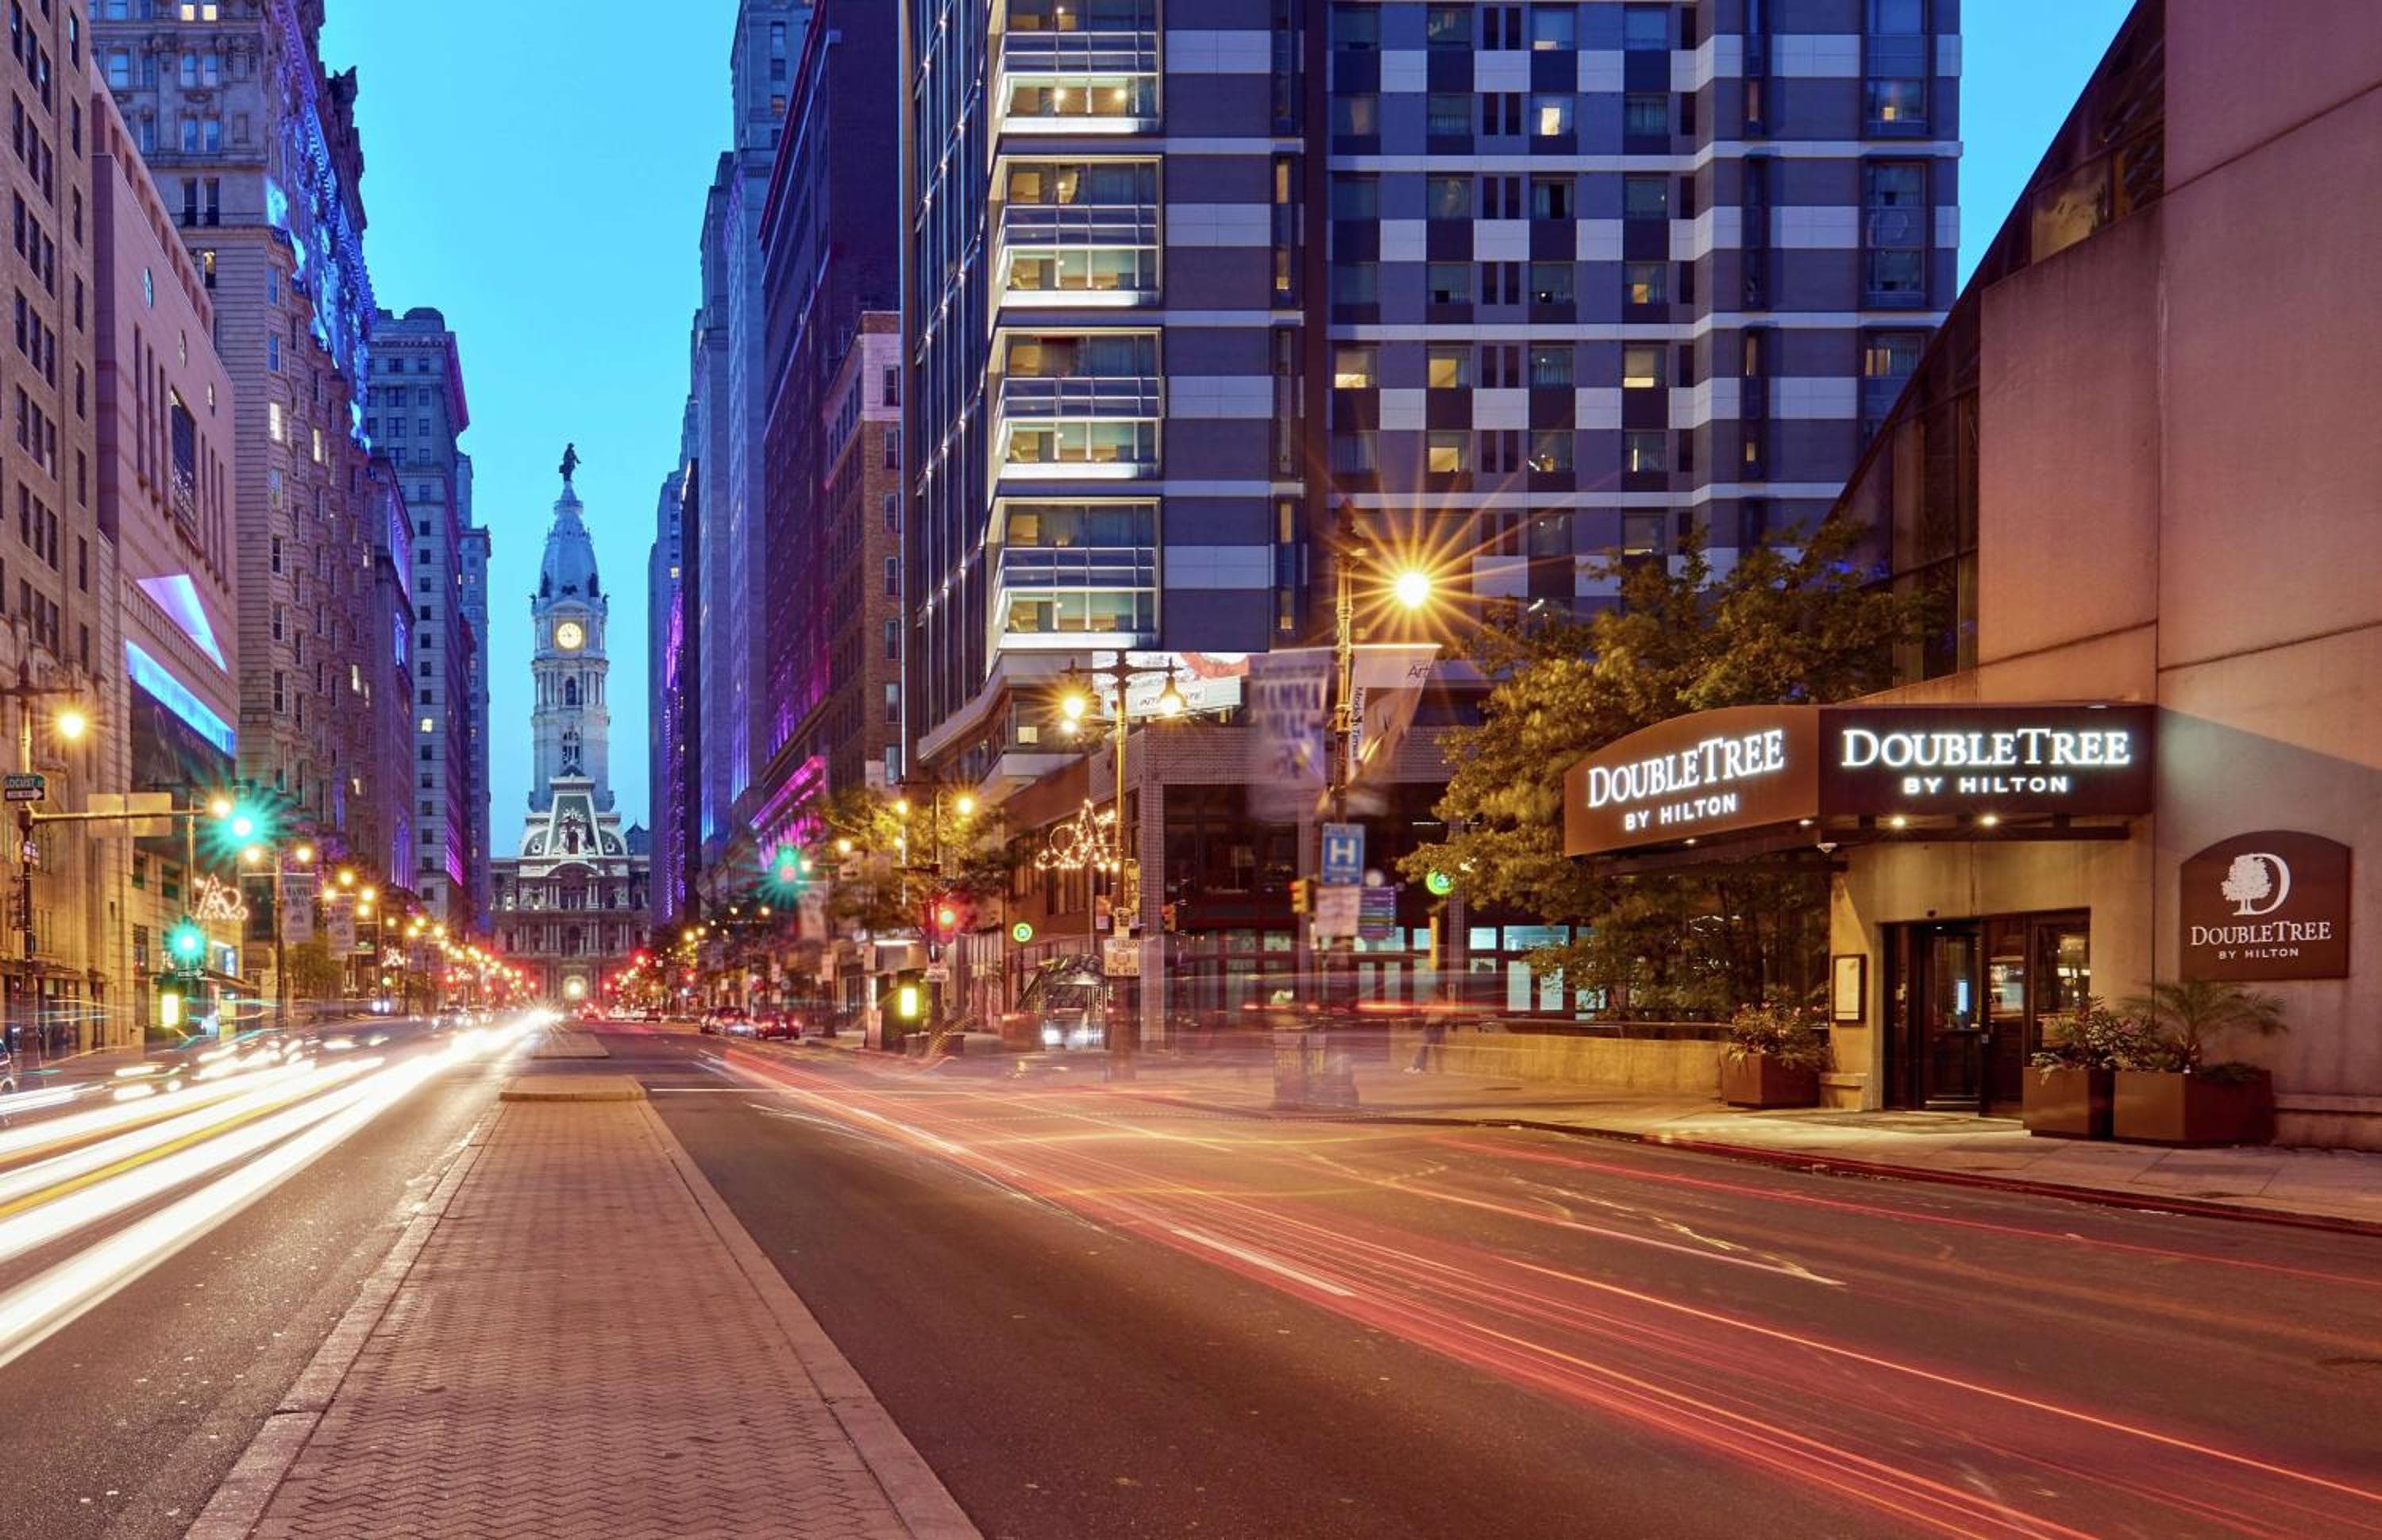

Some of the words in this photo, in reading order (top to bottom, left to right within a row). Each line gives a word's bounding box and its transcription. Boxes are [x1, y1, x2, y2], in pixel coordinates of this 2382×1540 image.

[1841, 728, 2130, 767] DOUBLETREE
[1587, 729, 1785, 808] DOUBLETREE
[1904, 776, 1942, 794] BY
[1959, 776, 2068, 794] HILTON
[1625, 810, 1650, 831] BY
[1660, 793, 1737, 825] HILTON
[1331, 837, 1355, 864] H
[2191, 921, 2332, 945] DOUBLETREE
[2218, 950, 2236, 960] BY
[2245, 948, 2299, 959] HILTON
